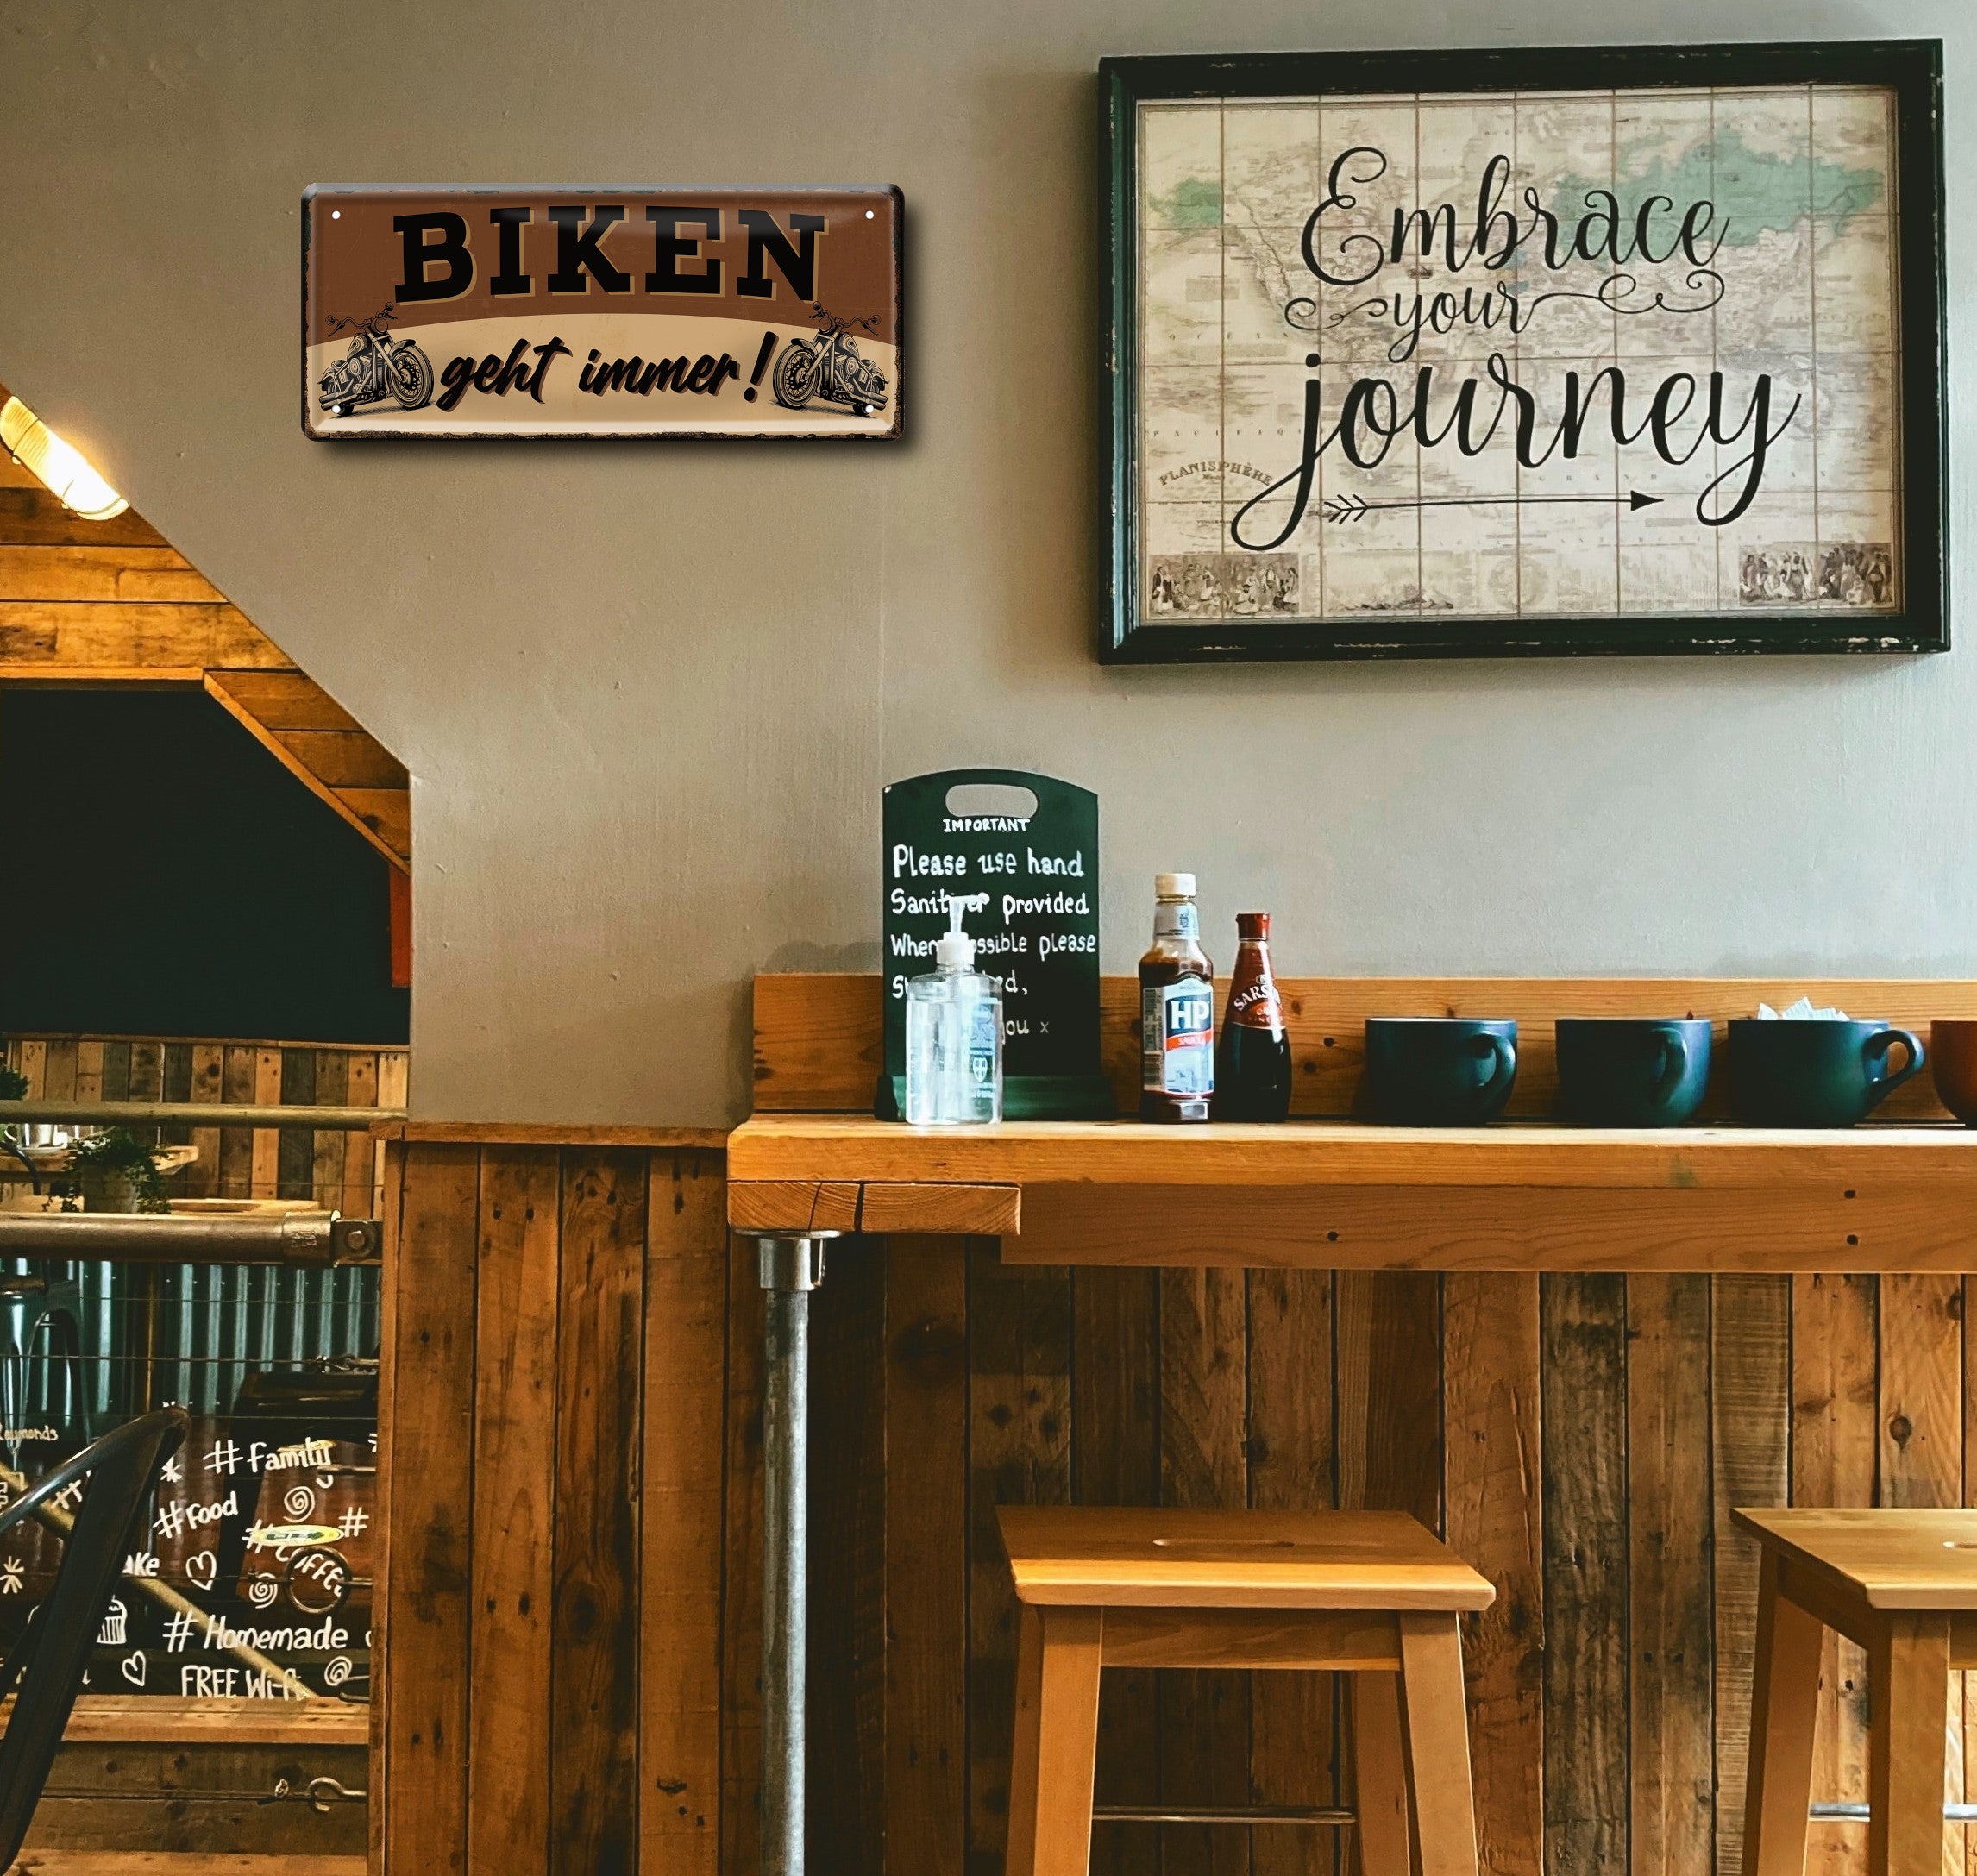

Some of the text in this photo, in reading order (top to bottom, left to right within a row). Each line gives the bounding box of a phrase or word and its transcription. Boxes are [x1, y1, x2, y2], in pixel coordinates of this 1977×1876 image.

[1301, 146, 1730, 286] Embrace
[392, 204, 829, 302] BIKEN
[1387, 280, 1535, 363] your
[436, 330, 779, 411] geht immer!
[1230, 352, 1802, 550] journey
[1159, 461, 1273, 486] PLANISPHÈRE
[943, 818, 1031, 832] IMPORTANT
[893, 844, 1085, 878] Please use hand
[1002, 891, 1090, 925] provided
[1039, 933, 1096, 962] please
[1171, 1000, 1210, 1030] HP
[203, 1614, 348, 1652] Homemade
[181, 1664, 240, 1699] FREE
